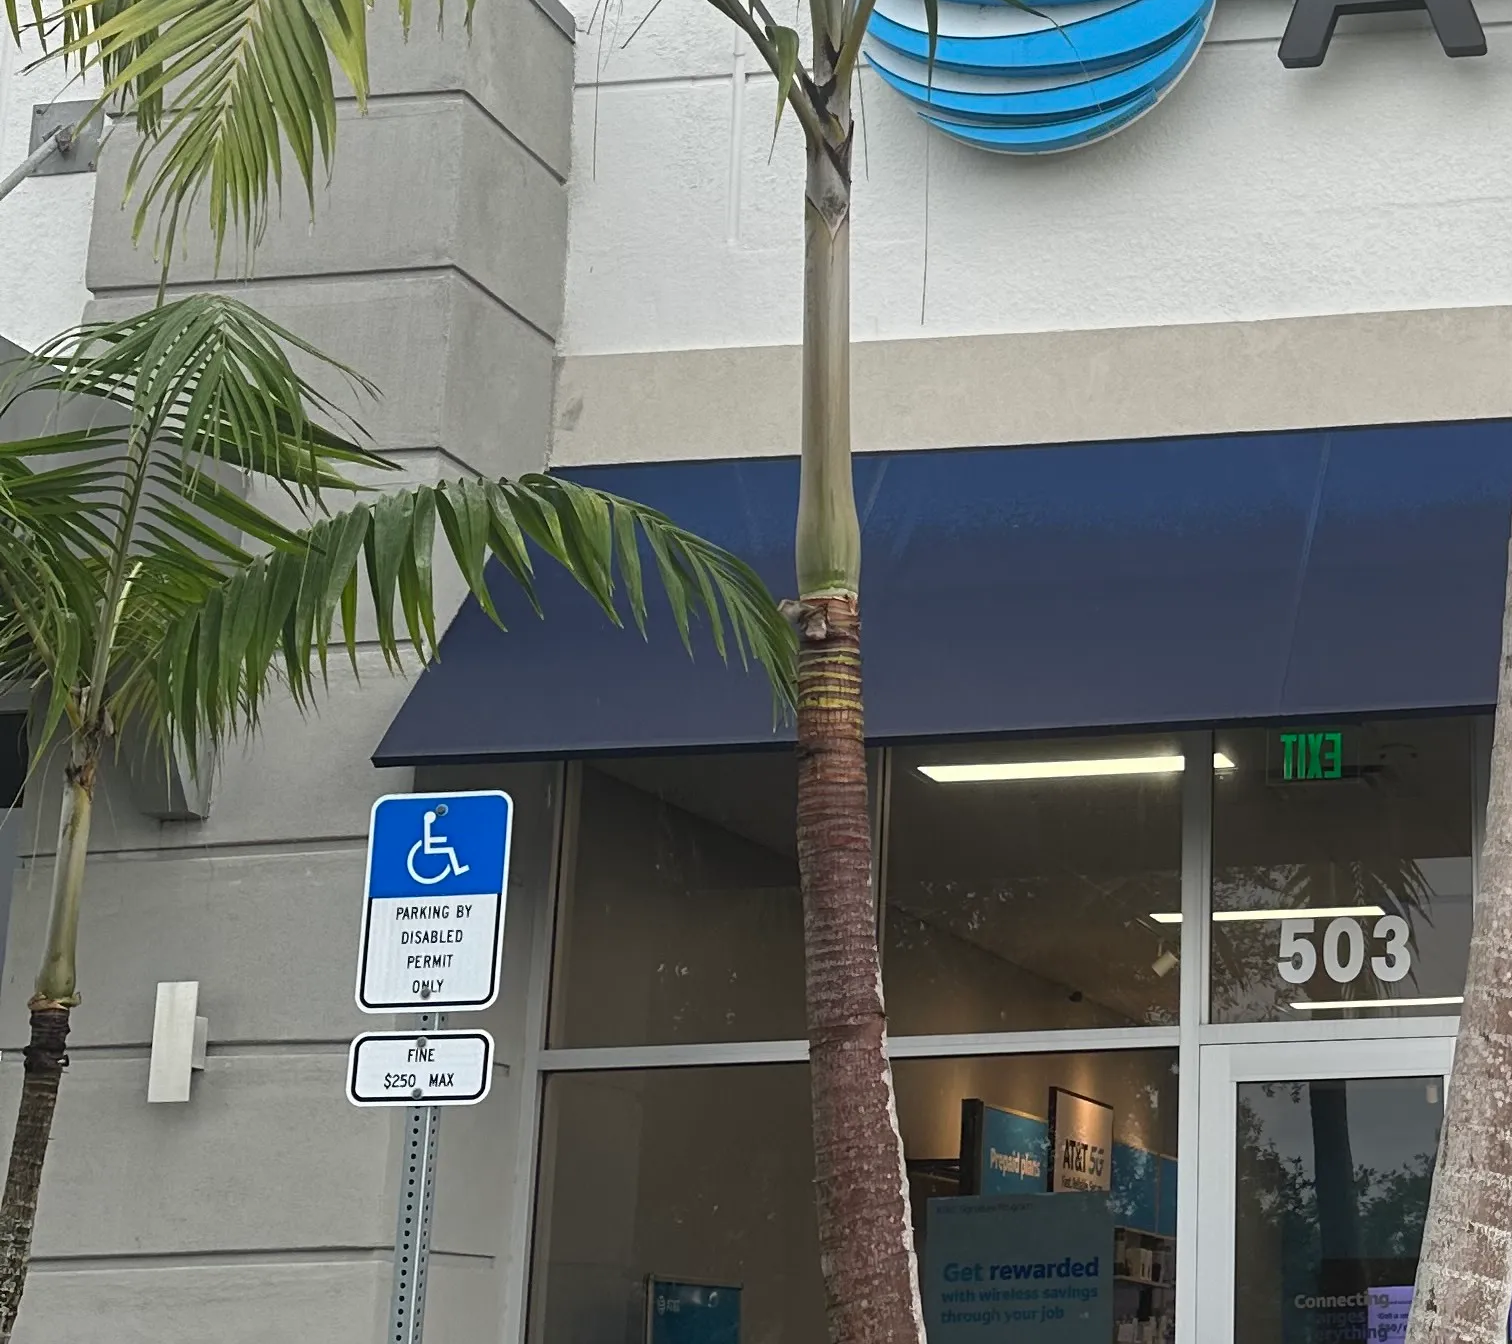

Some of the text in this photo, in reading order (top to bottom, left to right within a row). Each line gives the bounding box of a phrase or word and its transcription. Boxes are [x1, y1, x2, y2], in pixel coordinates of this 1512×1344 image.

[396, 904, 473, 920] PARKING BY
[401, 929, 463, 945] DISABLED
[1277, 914, 1411, 984] 503
[407, 954, 453, 969] PERMIT
[412, 979, 444, 994] ONLY
[407, 1048, 435, 1063] FINE
[383, 1072, 454, 1089] $250 MAX
[943, 1256, 1099, 1282] Get rewarded
[941, 1285, 1098, 1303] with wireless savings
[1294, 1290, 1389, 1308] Connecting
[941, 1306, 1064, 1325] through your job
